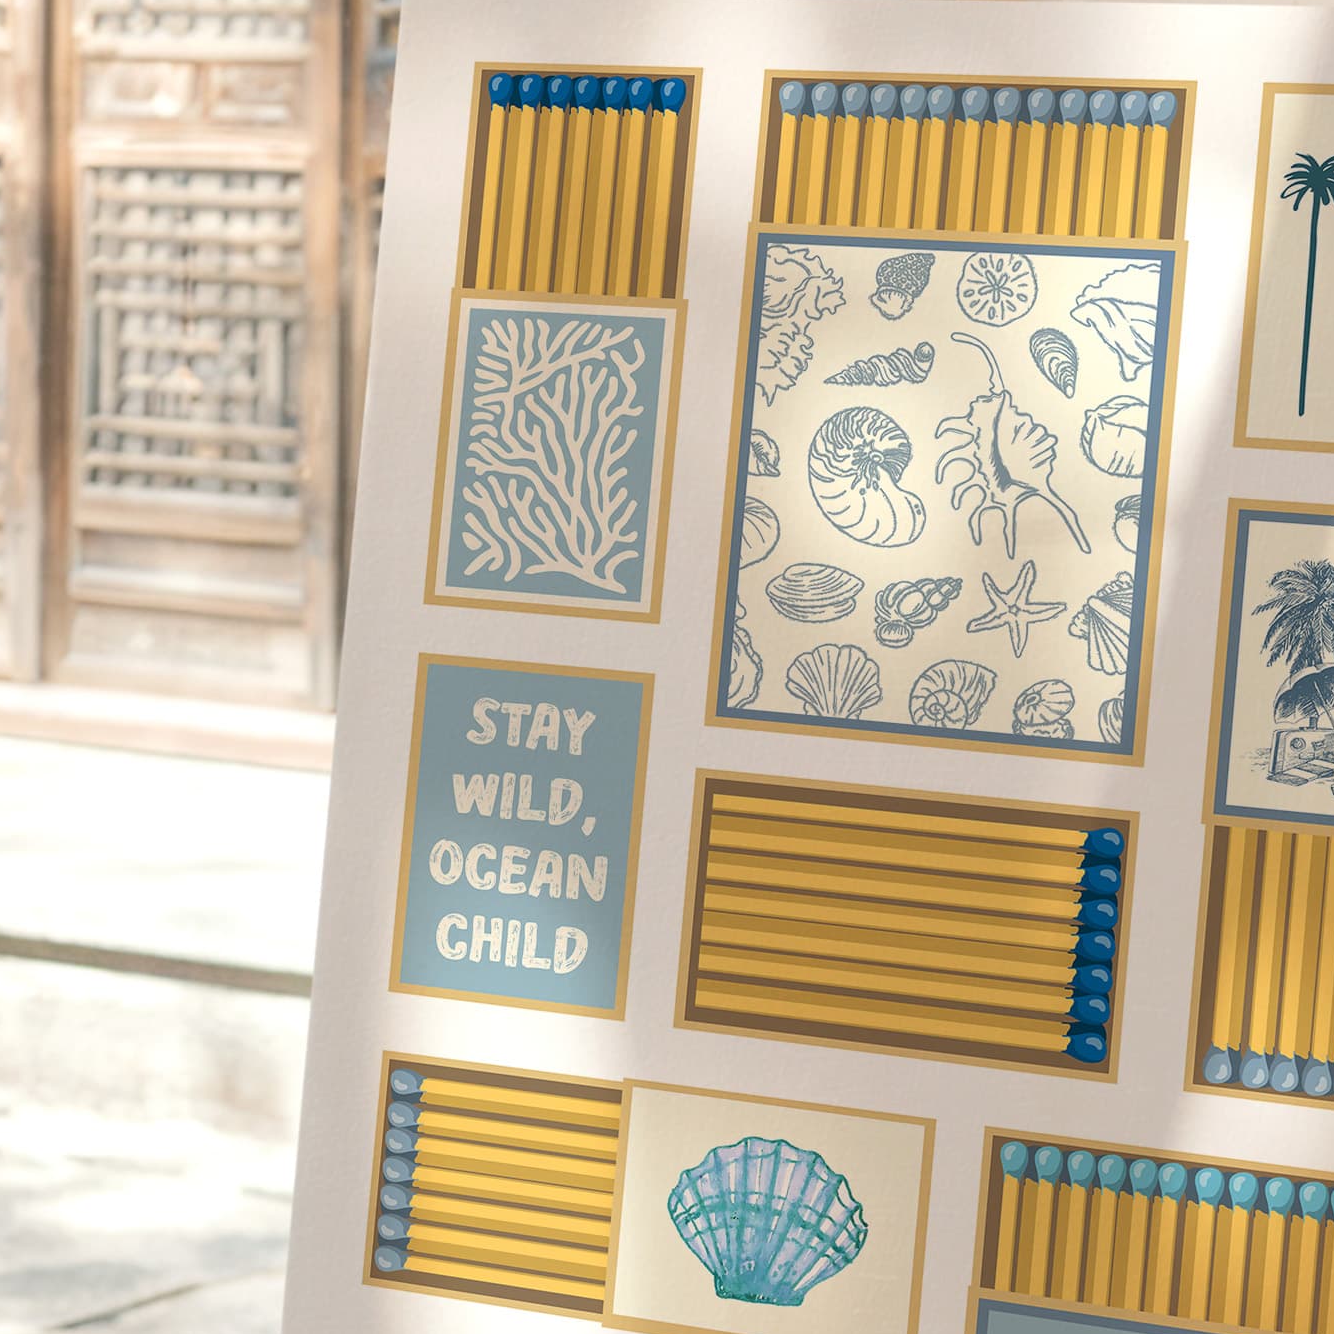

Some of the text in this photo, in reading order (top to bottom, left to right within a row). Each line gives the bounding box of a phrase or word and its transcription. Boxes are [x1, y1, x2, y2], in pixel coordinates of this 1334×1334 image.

[466, 697, 596, 755] STAY
[452, 772, 596, 836] WILD,
[428, 838, 608, 902] OCEAN
[435, 912, 589, 975] CHILD
